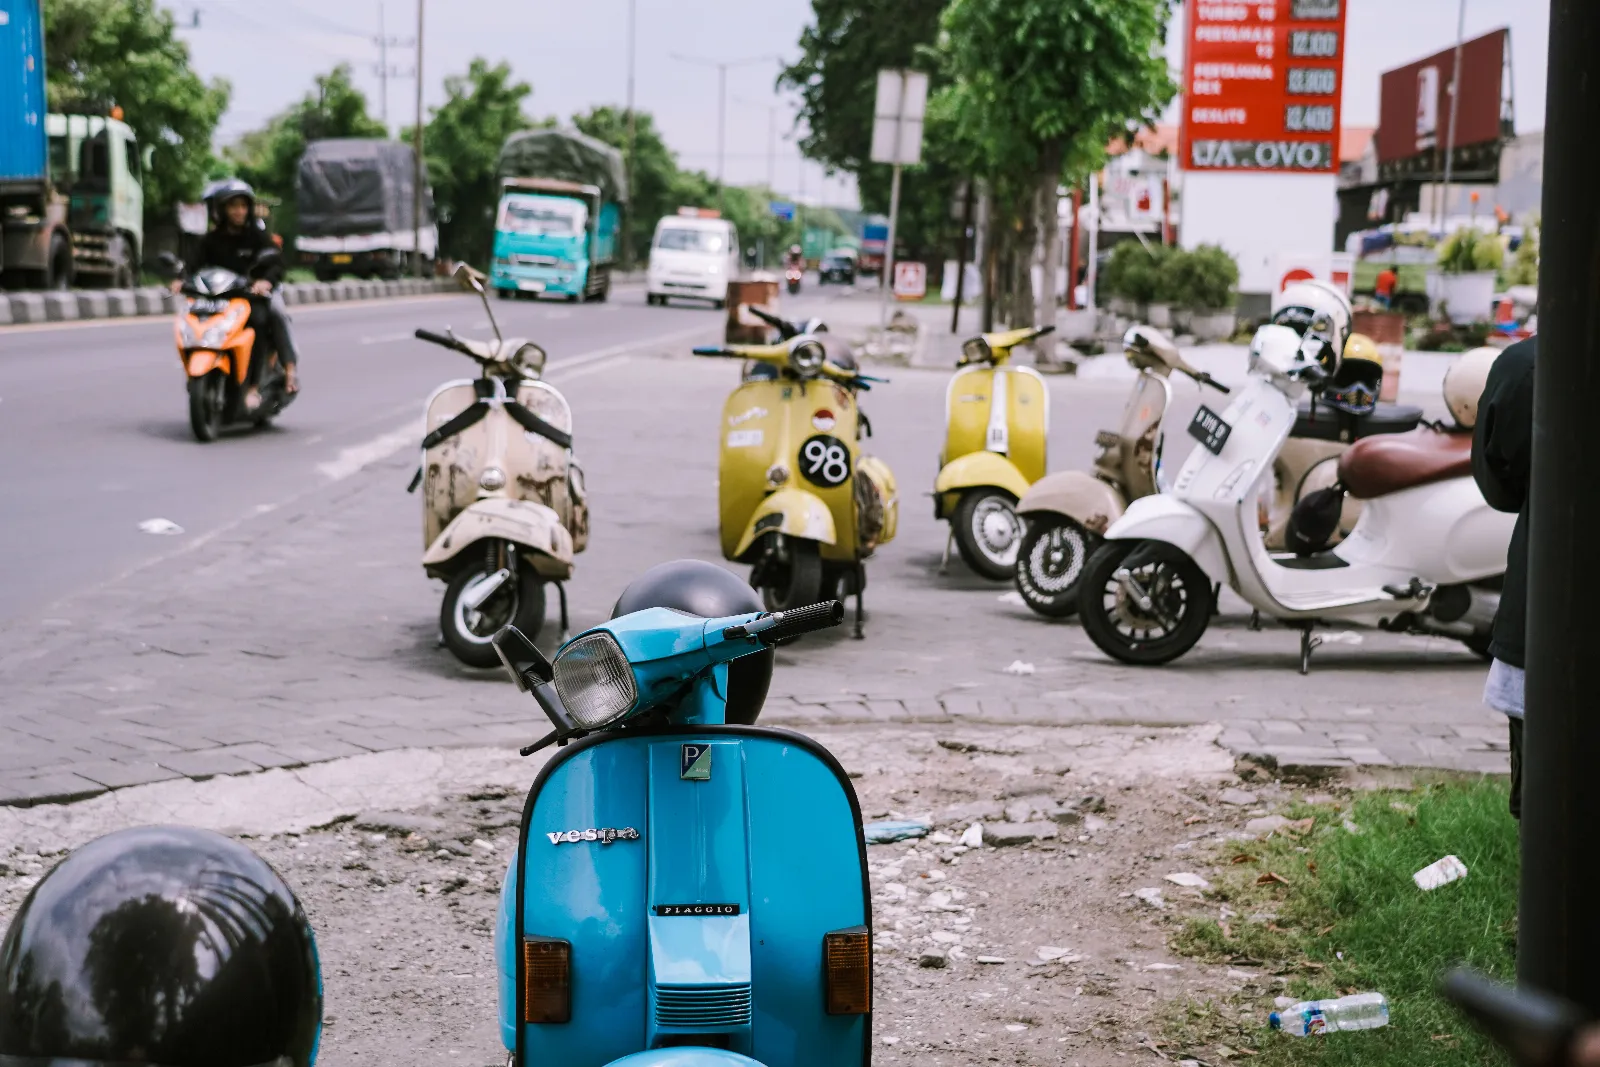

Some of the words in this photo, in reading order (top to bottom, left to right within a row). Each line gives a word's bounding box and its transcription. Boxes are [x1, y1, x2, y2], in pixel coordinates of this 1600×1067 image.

[805, 440, 848, 483] 98
[684, 746, 699, 766] P
[664, 905, 734, 915] PIAGGIO
